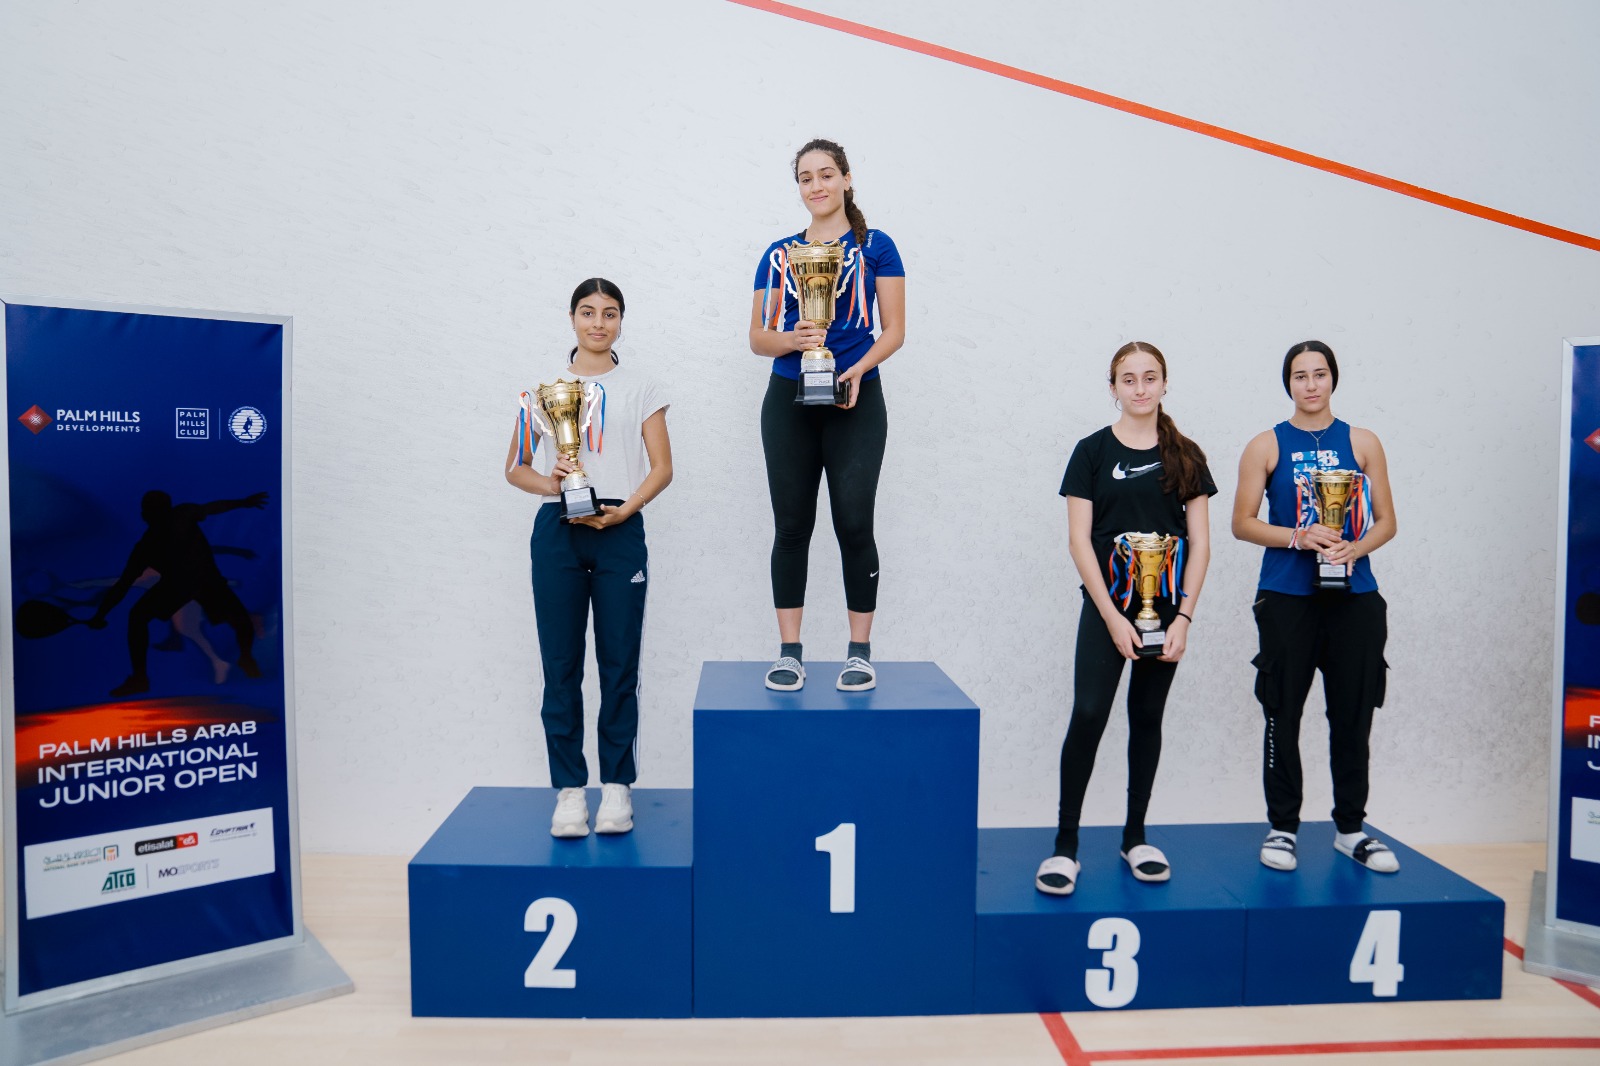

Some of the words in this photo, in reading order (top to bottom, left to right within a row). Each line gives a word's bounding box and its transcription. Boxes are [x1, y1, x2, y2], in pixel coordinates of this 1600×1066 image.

[56, 409, 97, 421] PALM
[100, 410, 141, 423] HILLS
[56, 424, 141, 433] DEVELOPMENTS
[38, 736, 111, 759] PALM
[117, 728, 188, 749] HILLS
[193, 720, 257, 741] ARAB
[38, 742, 259, 784] INTERNATIONAL
[38, 773, 166, 808] JUNIOR
[173, 761, 258, 789] OPEN
[138, 839, 174, 853] etisalat
[101, 868, 136, 891] ATCO
[815, 823, 856, 913] 1
[523, 896, 578, 989] 2
[1084, 917, 1141, 1009] 3
[1349, 909, 1405, 997] 4
